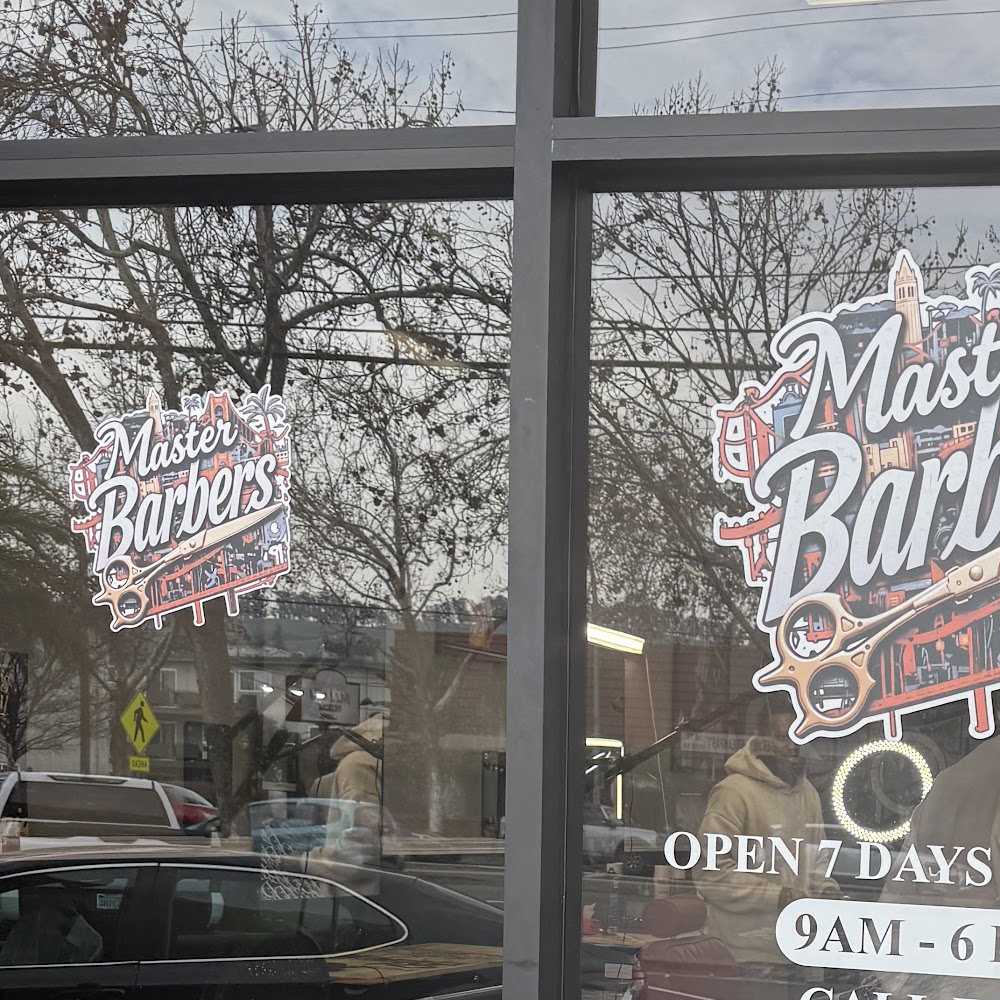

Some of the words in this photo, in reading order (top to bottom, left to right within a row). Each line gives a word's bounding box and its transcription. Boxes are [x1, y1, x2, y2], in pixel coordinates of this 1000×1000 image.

[96, 417, 239, 480] Master
[88, 454, 276, 572] Barbers
[665, 831, 803, 876] OPEN
[818, 839, 843, 878] 7
[855, 842, 992, 887] DAYS
[795, 913, 905, 957] 9AM
[919, 941, 935, 949] -
[950, 923, 975, 961] 6
